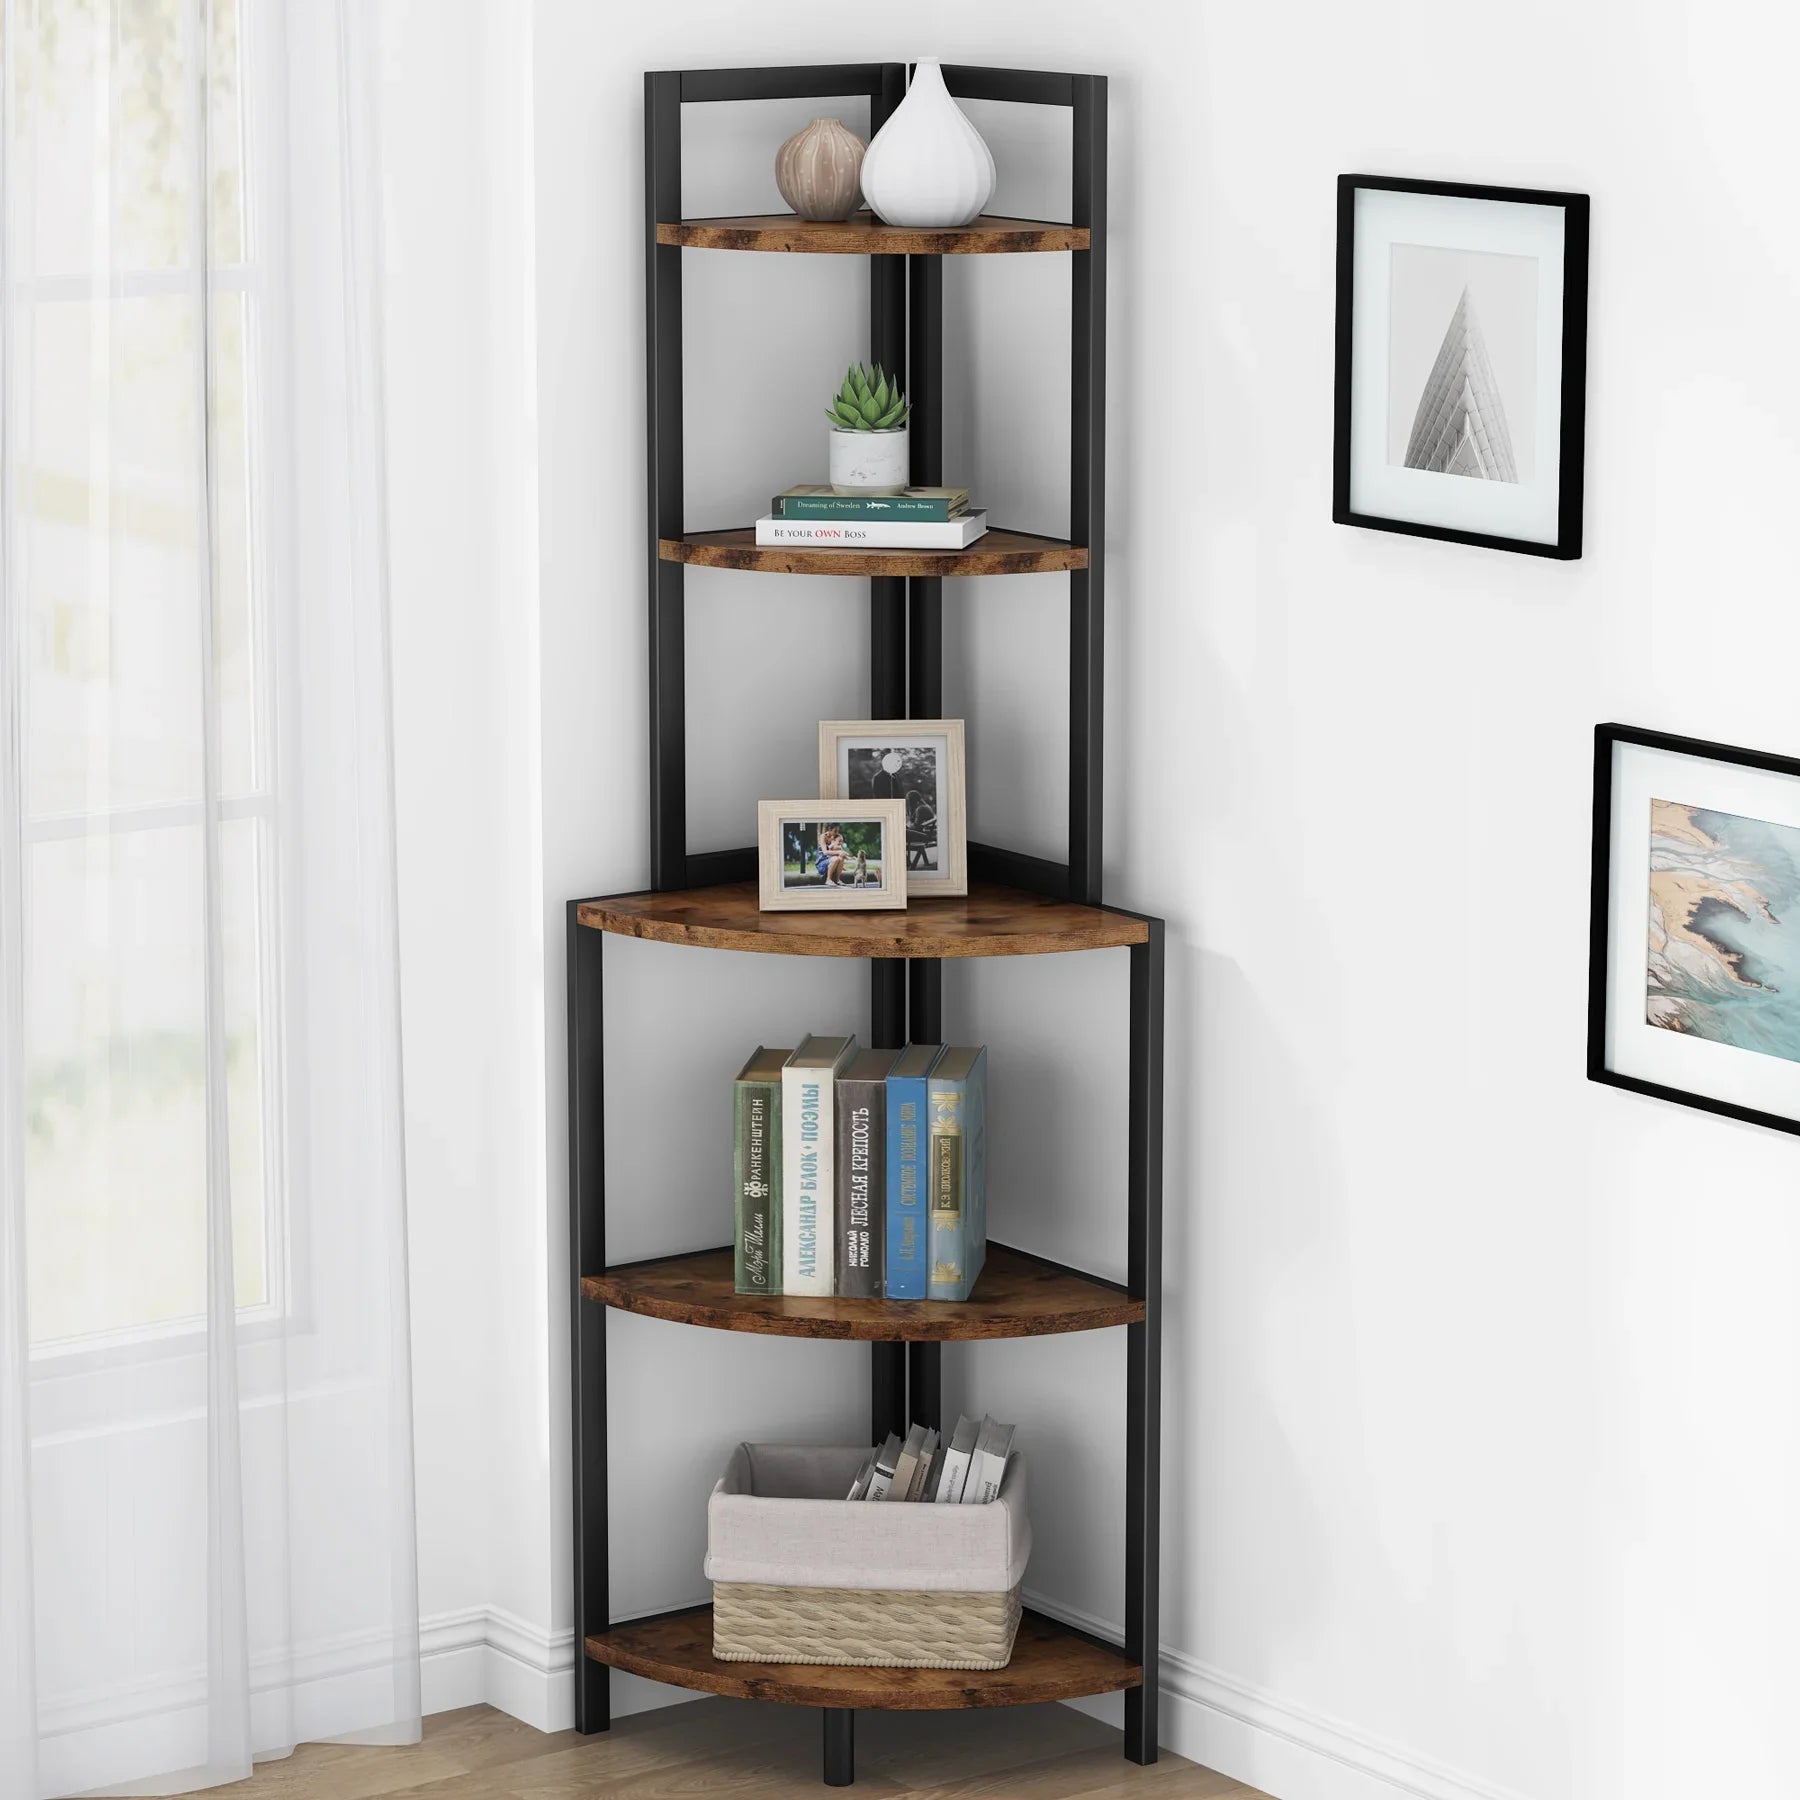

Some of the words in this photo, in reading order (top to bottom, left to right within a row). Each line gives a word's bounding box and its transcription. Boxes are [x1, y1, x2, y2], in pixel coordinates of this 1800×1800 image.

[797, 501, 828, 510] Dreaming
[828, 501, 835, 509] of
[836, 501, 861, 509] Sweden
[787, 529, 813, 538] YOUR
[815, 529, 841, 538] OWN
[844, 530, 867, 539] BOSS
[801, 1083, 820, 1142] ПОЭМЫ
[744, 1098, 769, 1198] ФРАНКЕНШТЕЙН
[853, 1107, 870, 1171] КРЕПОСТЬ
[800, 1151, 818, 1191] БЛОК
[852, 1174, 869, 1227] ЛЕСНАЯ
[745, 1212, 764, 1254] Шелли
[799, 1195, 817, 1278] АЛЕКСАНДР
[848, 1230, 858, 1267] НИКОЛАЙ
[860, 1231, 870, 1268] ГОМОЛКО
[746, 1249, 769, 1285] Мэри
